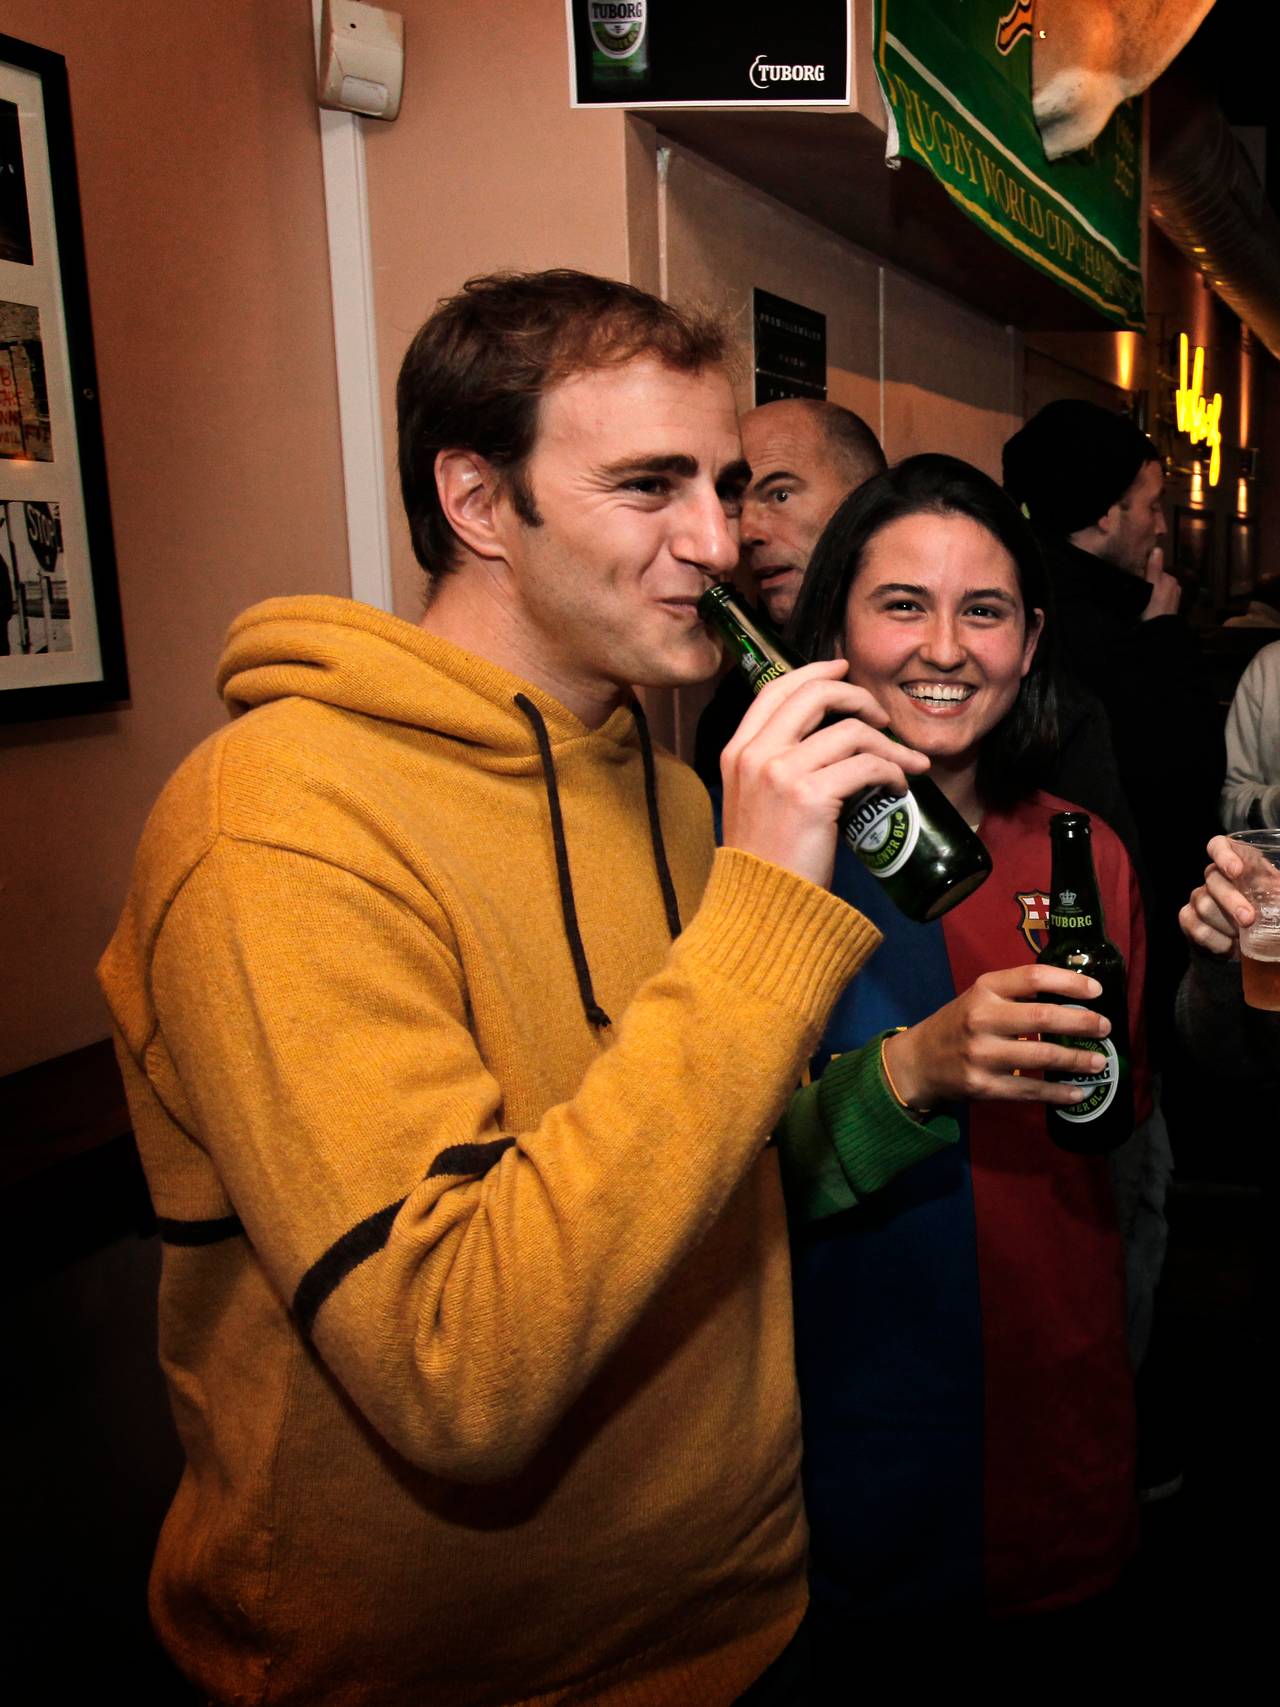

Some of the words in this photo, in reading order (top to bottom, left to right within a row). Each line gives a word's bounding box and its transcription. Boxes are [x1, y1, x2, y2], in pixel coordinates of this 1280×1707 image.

[592, 3, 642, 19] TUBORG
[757, 64, 826, 82] TUBORG
[894, 73, 978, 185] RUGBY
[975, 149, 1045, 239] WORLD
[1045, 208, 1076, 262] CUP
[1050, 913, 1093, 929] TUBORG
